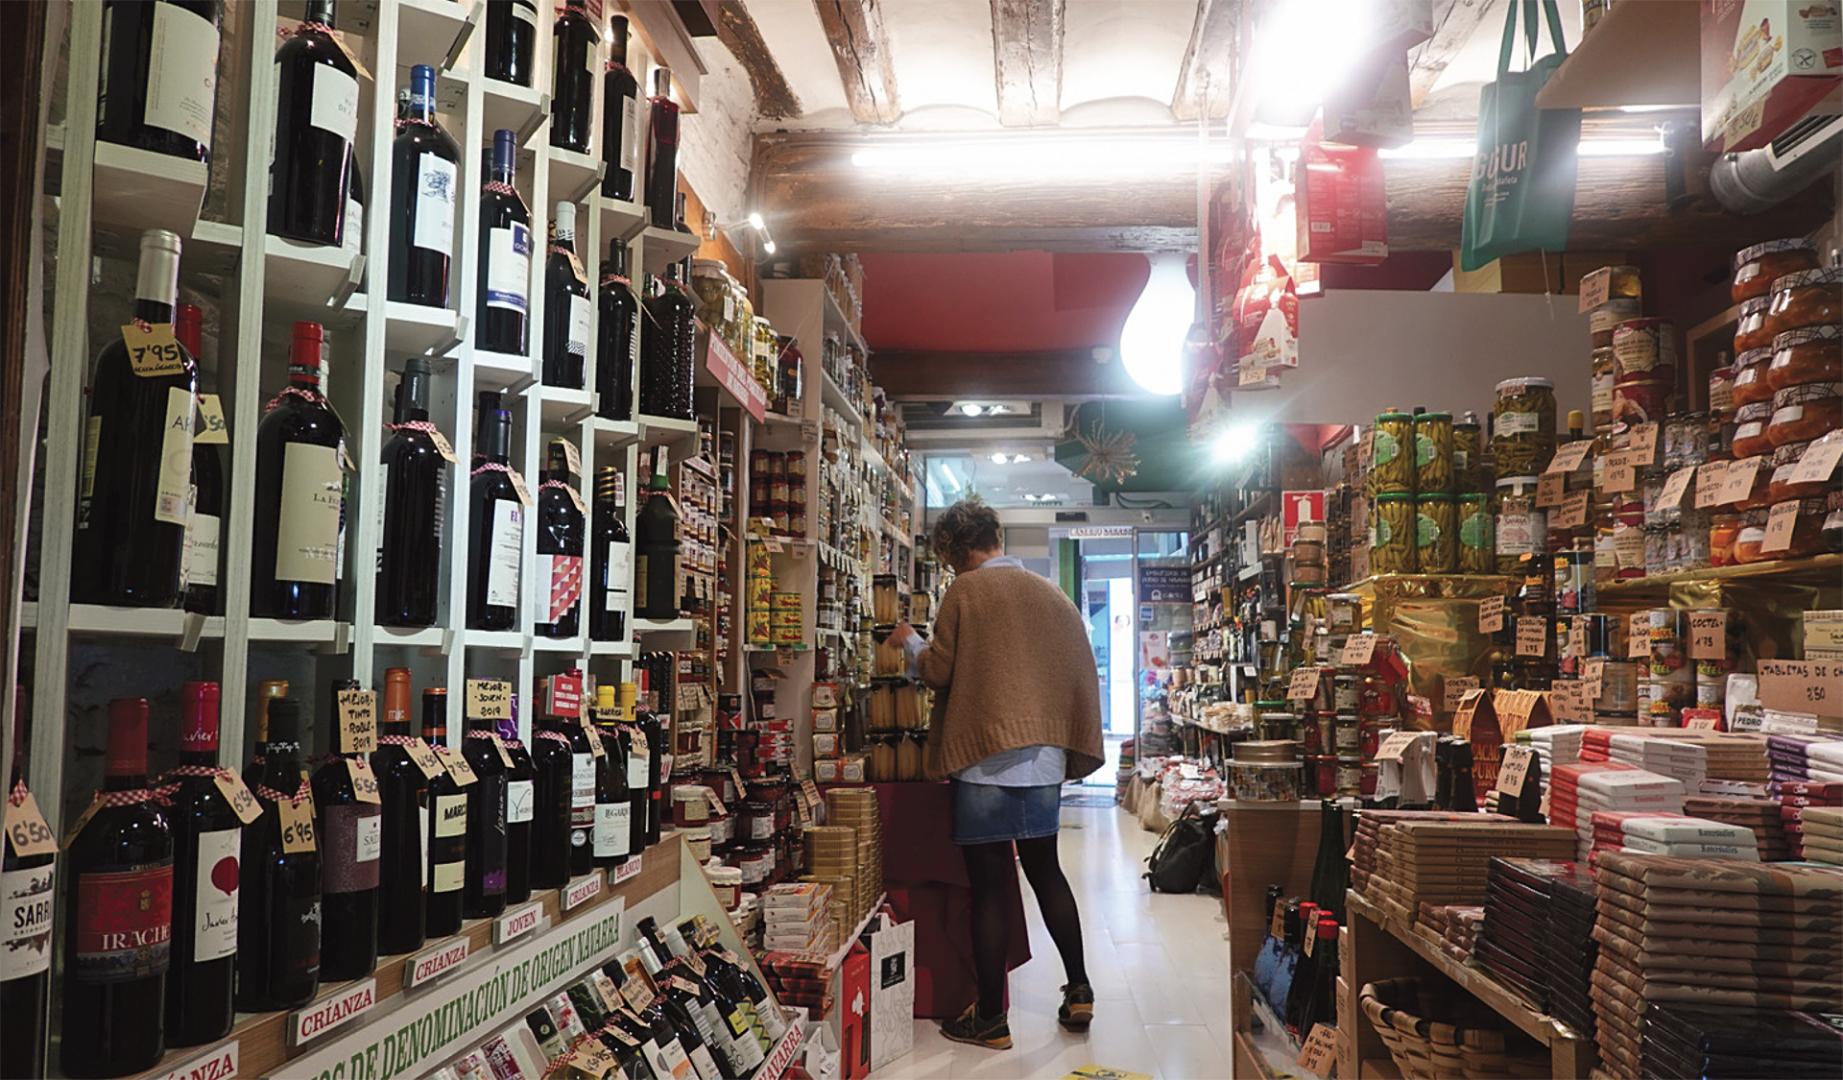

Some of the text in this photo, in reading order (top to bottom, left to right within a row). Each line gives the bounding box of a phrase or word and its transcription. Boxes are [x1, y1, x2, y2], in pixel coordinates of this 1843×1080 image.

[132, 344, 178, 363] 7'95
[1763, 664, 1809, 677] TABLETAS
[1814, 666, 1827, 677] DE
[1737, 715, 1763, 726] PEDRO
[12, 820, 51, 847] 6'50
[283, 820, 313, 845] 6'95
[615, 858, 642, 880] BLANCO
[507, 910, 537, 938] JOVEN
[350, 1042, 379, 1080] DE
[382, 965, 512, 1078] DENOMINACIÓN
[510, 959, 532, 1004] DE
[531, 931, 577, 993] ORIGEN
[575, 912, 621, 966] NAVARRA
